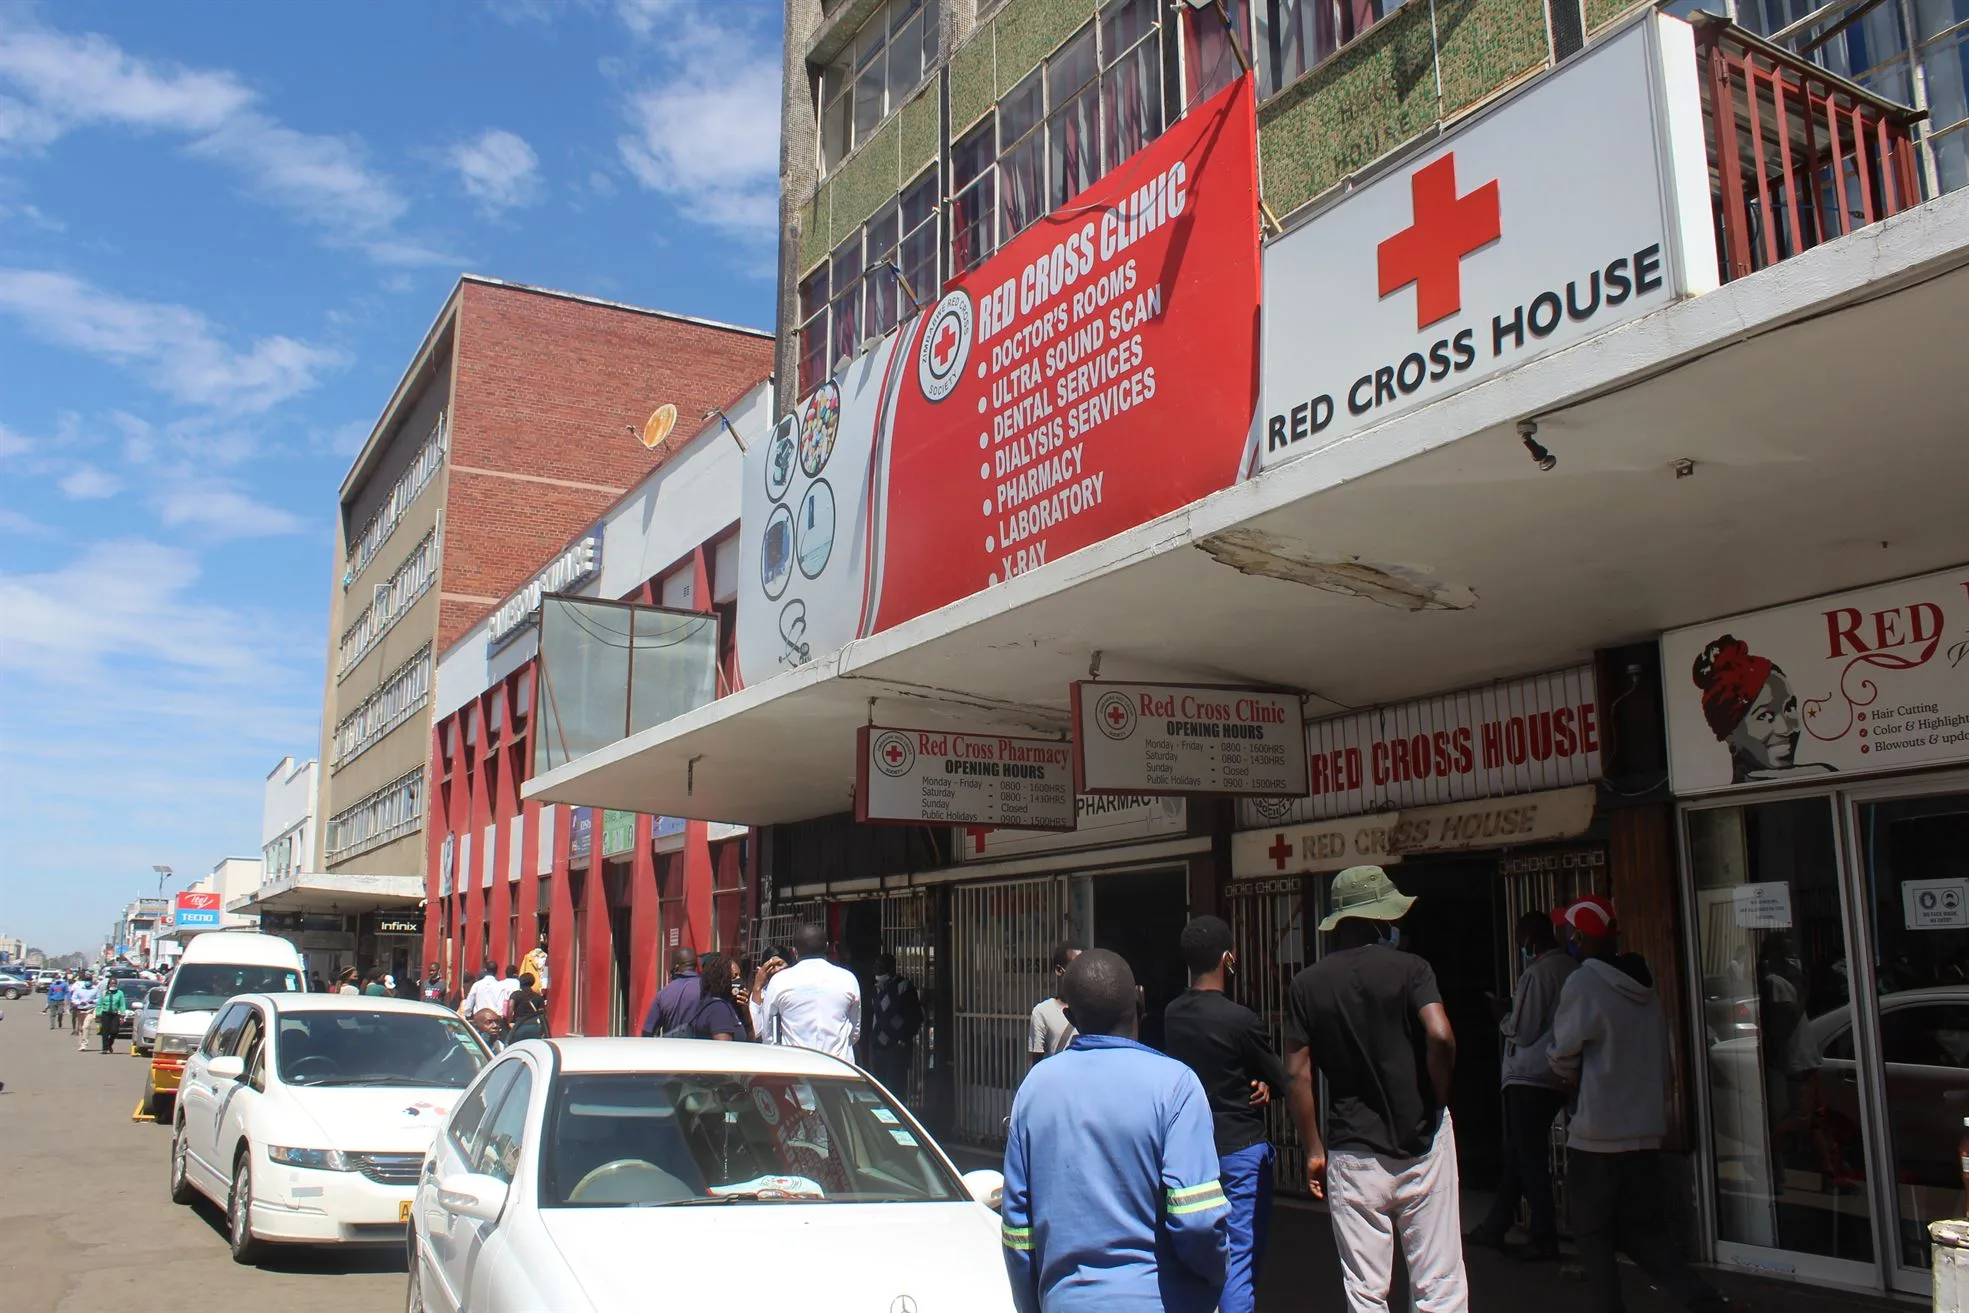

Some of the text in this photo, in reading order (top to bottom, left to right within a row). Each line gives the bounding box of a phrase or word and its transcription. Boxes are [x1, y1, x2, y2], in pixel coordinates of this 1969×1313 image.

[978, 160, 1187, 344] RED CROSS CLINIC
[1072, 259, 1137, 320] ROOMS
[992, 283, 1161, 409] ULTRA SOUND SCAN
[1268, 242, 1662, 452] RED CROSS HOUSE
[929, 370, 957, 396] SOCIETY
[994, 334, 1144, 444] DENTAL SERVICES
[995, 366, 1156, 479] DIALYSIS SERVICES
[996, 443, 1084, 513] PHARMACY
[1000, 472, 1104, 548] LABORATORY
[1001, 542, 1047, 582] X-RAY
[1821, 602, 1944, 660] RED
[1139, 693, 1175, 718] Red
[1181, 696, 1229, 720] Cross
[1236, 698, 1285, 723] Clinic
[1872, 703, 1938, 720] Hair Cutting
[1167, 721, 1264, 740] OPENING HOURS
[1873, 724, 1902, 736] Color
[918, 733, 948, 756] Red
[953, 735, 994, 760] Cross
[998, 740, 1070, 770] Pharmacy
[1145, 751, 1178, 762] Saturday
[1222, 755, 1242, 764] 0800
[1146, 739, 1174, 750] Monday
[1182, 740, 1204, 752] Friday
[1221, 742, 1241, 752] 0800
[1312, 704, 1599, 795] RED CROSS HOUSE
[1875, 739, 1926, 752] Blowouts
[945, 759, 1044, 779] OPENING HOURS
[1146, 762, 1248, 776] Sunday Closed
[1147, 776, 1169, 784] Public
[1170, 776, 1200, 786] Holidays
[1223, 779, 1243, 788] 0900
[922, 776, 952, 788] Monday
[960, 779, 982, 790] Friday
[1000, 782, 1021, 791] 0800
[922, 787, 955, 798] Saturday
[1000, 793, 1021, 802] 0800
[922, 799, 1028, 813] Sunday Closed
[922, 810, 944, 820] Public
[946, 812, 978, 822] Holidays
[1000, 816, 1021, 824] 0900
[1302, 833, 1345, 861] RED
[1440, 805, 1538, 842] HOUSE
[381, 922, 416, 931] Infinix
